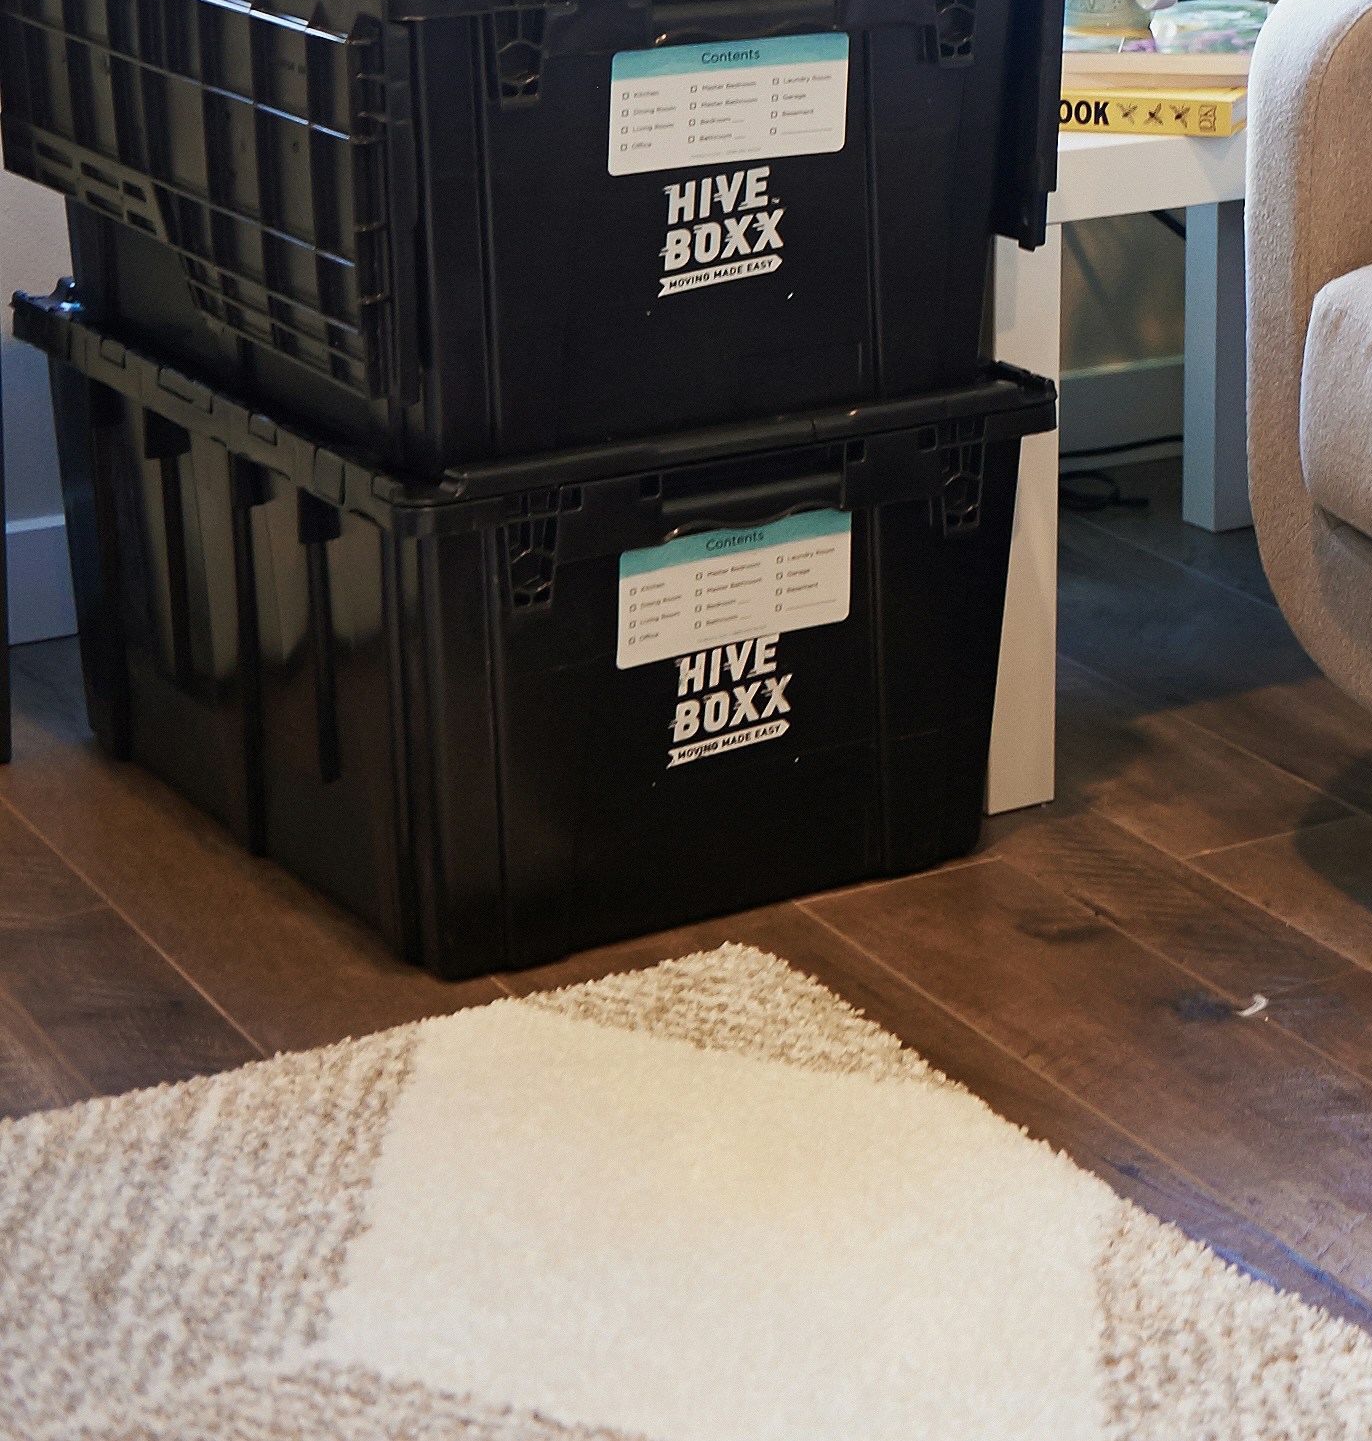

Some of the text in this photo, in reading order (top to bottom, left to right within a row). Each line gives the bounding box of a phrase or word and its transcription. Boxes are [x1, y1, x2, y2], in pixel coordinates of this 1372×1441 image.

[701, 48, 761, 65] Contents
[1059, 100, 1110, 126] OOK
[663, 165, 771, 225] HIVE
[659, 208, 785, 272] BOXX
[668, 258, 774, 290] MOVING MADE EASY
[705, 530, 764, 551] Contents
[674, 632, 781, 697] HIVE
[668, 672, 793, 743] BOXX
[677, 723, 782, 760] MOVING MADE EASY
